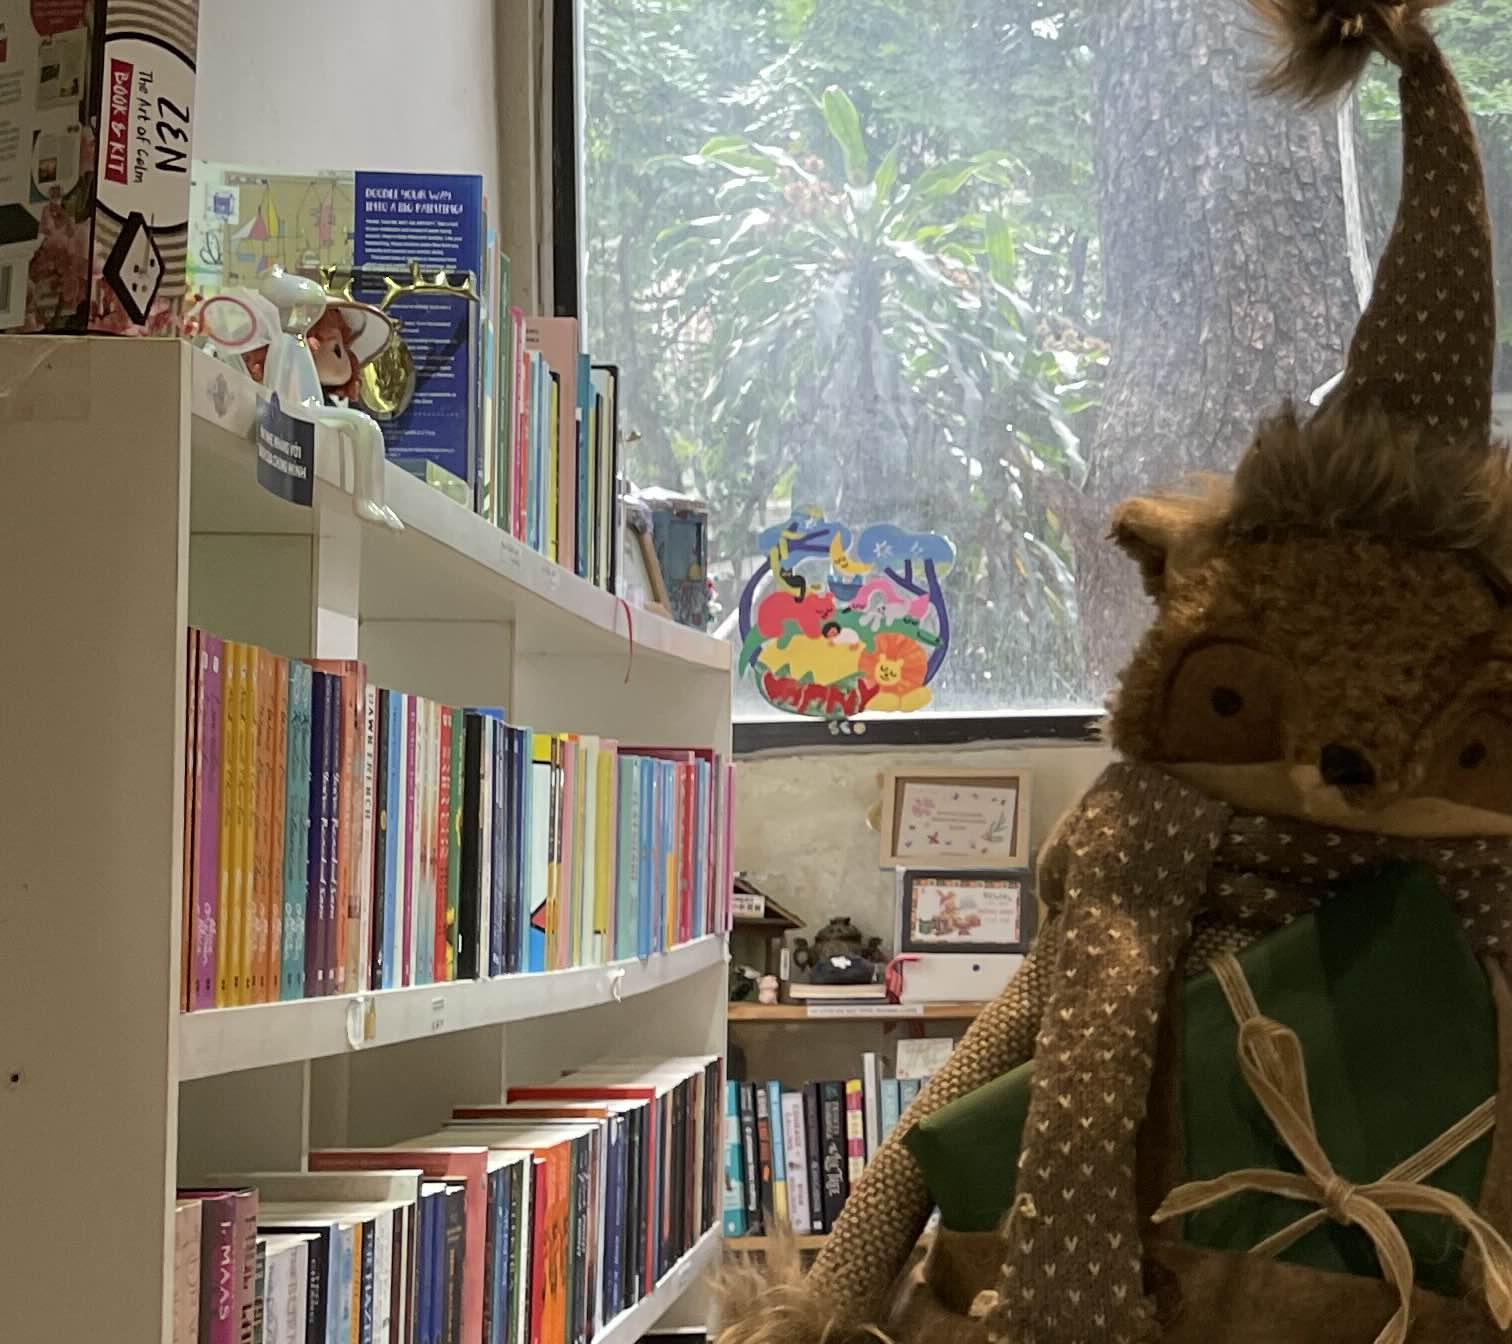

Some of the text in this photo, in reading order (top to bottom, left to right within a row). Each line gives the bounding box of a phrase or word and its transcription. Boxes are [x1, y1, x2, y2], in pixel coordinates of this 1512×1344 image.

[139, 71, 153, 94] The
[108, 72, 128, 174] BOOK & KIT
[137, 98, 151, 121] Art
[136, 127, 151, 144] of
[155, 97, 189, 172] ZEN
[218, 1245, 231, 1320] MAAS
